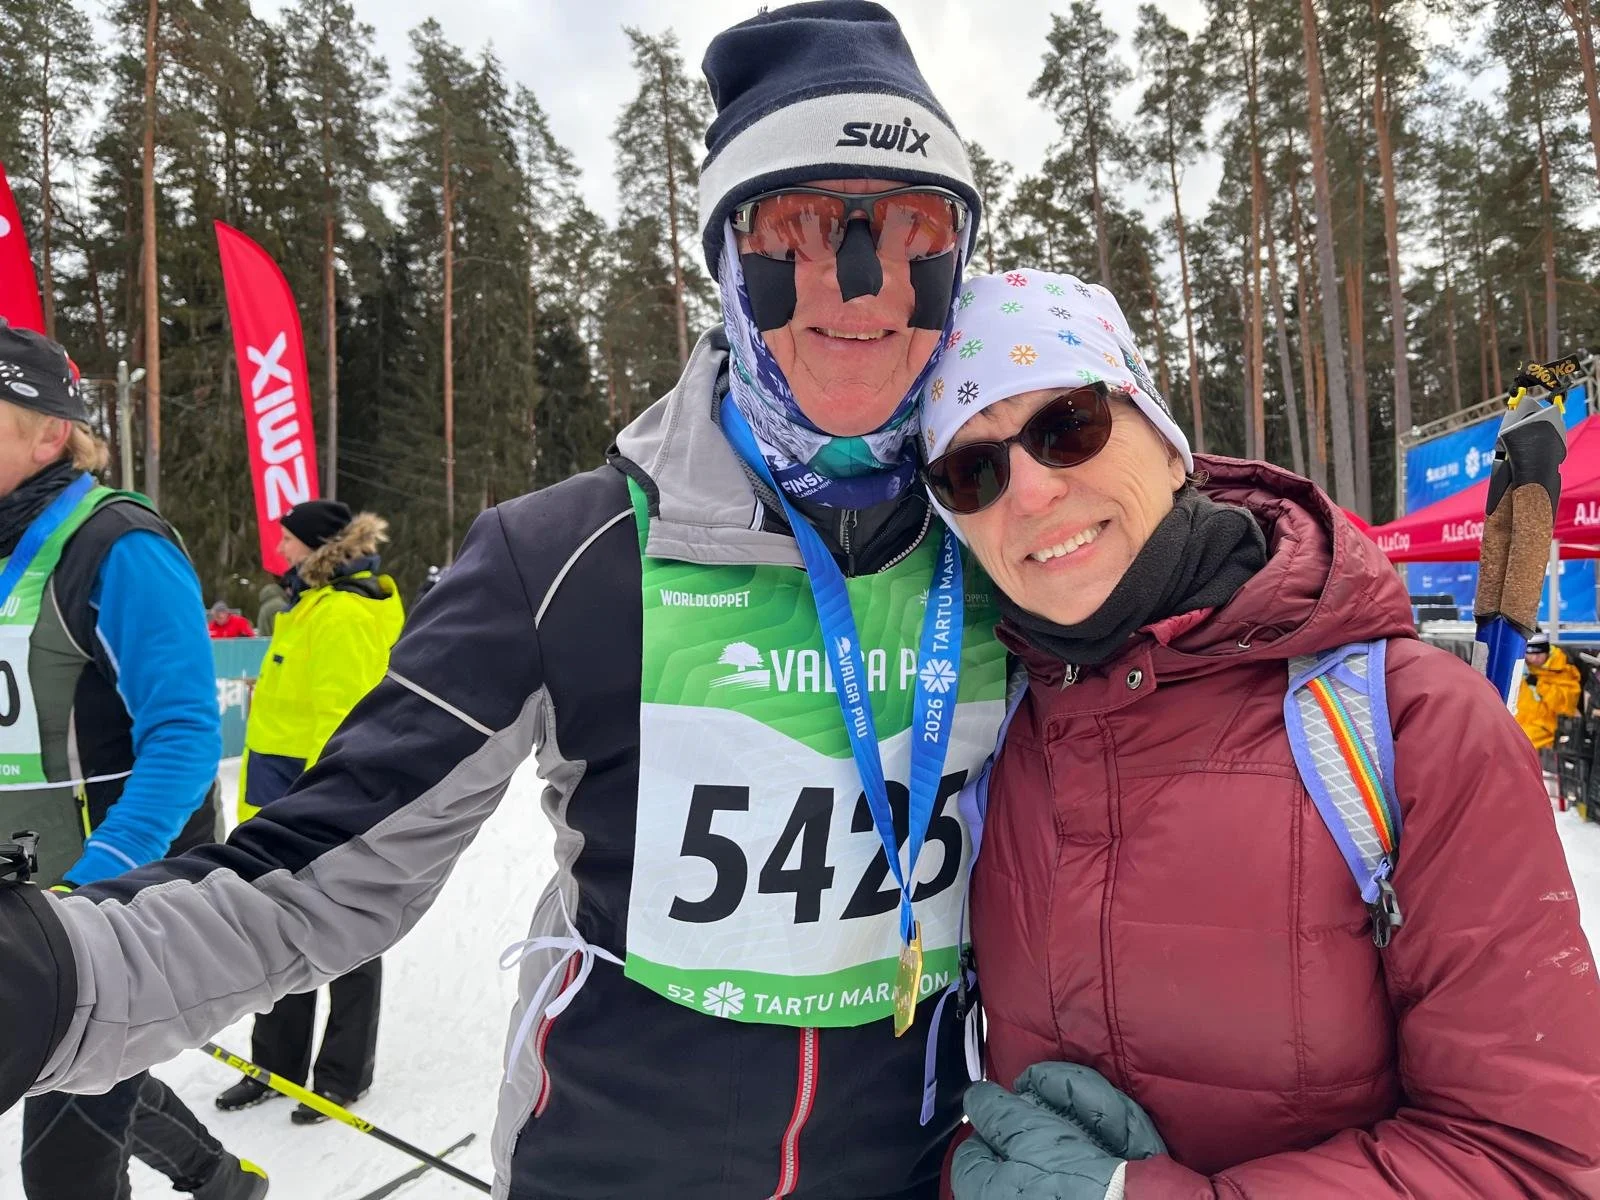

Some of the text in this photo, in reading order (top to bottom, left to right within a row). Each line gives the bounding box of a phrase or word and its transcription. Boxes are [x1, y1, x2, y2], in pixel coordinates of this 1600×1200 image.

[660, 588, 750, 608] WORLDLOPPET
[924, 525, 954, 744] 2026 TARTU MARAT
[770, 648, 887, 693] VALA
[839, 655, 868, 739] VALGA PUU
[668, 769, 968, 924] 5425
[667, 983, 695, 1003] 52
[754, 992, 833, 1016] TARTU
[839, 970, 949, 1008] MARON
[212, 1047, 261, 1079] LEKI
